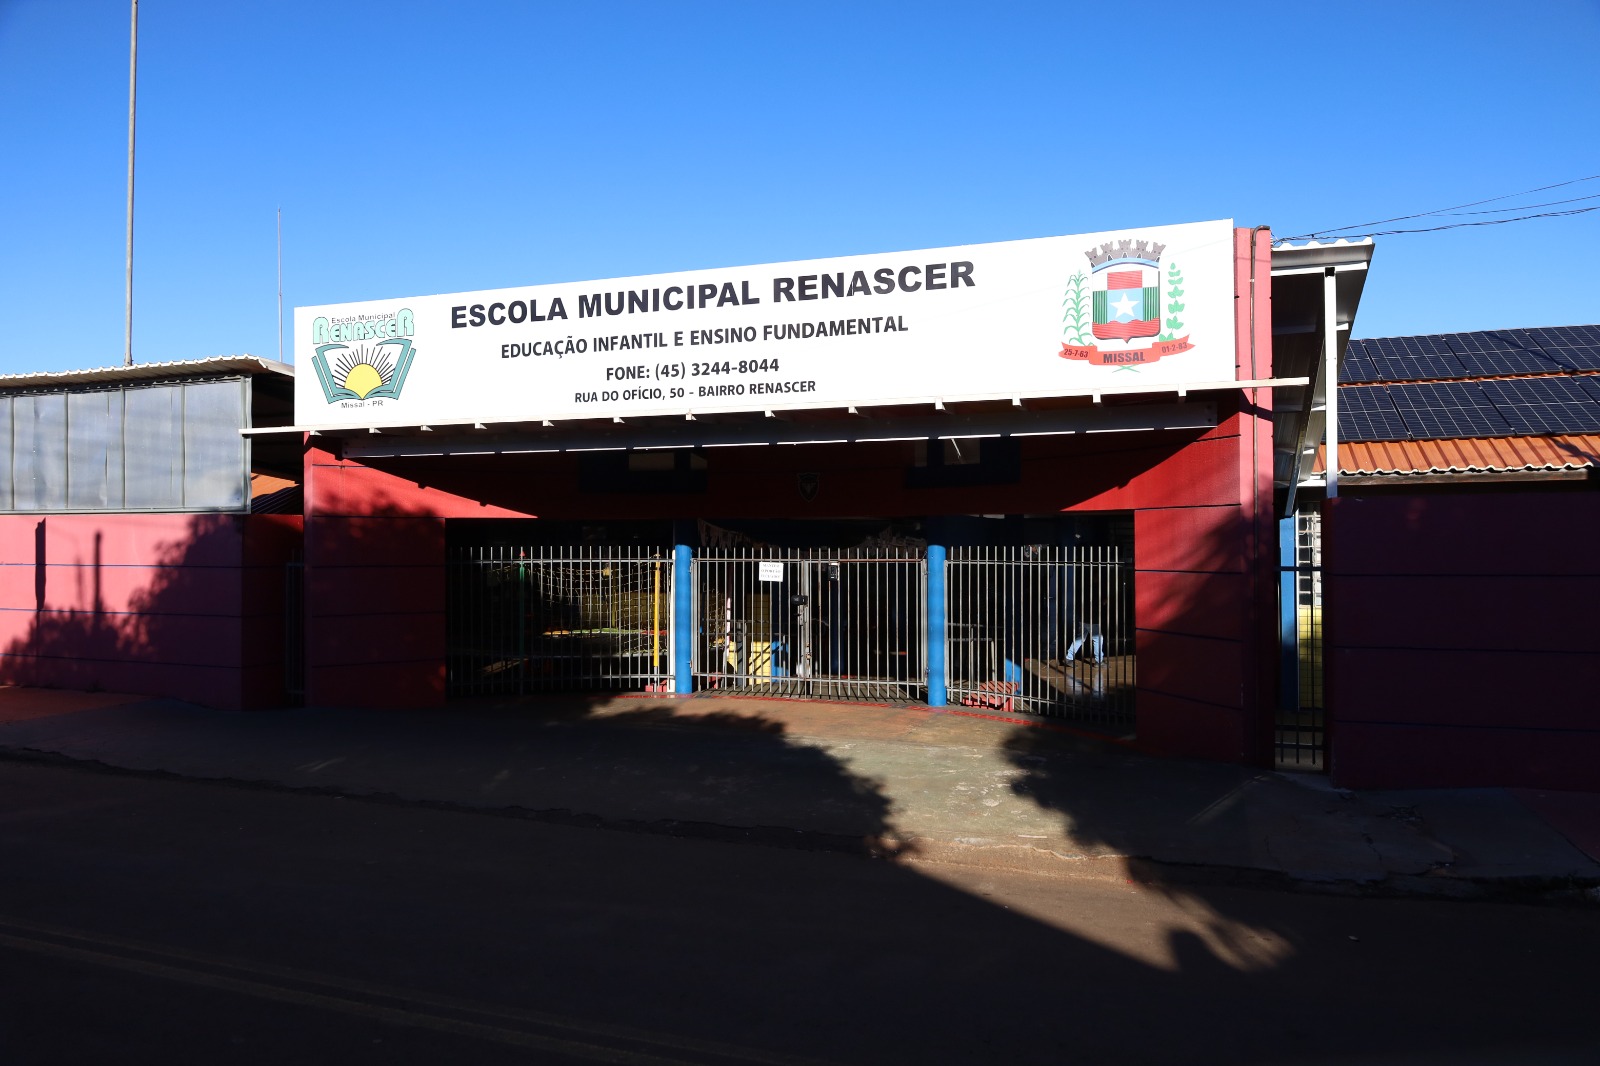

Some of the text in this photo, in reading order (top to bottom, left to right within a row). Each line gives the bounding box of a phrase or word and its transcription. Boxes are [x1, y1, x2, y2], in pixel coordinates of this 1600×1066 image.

[451, 260, 976, 329] ESCOLA MUNICIPAL RENASCER
[313, 308, 414, 344] RENASCER
[331, 312, 396, 324] Escola Municipal
[501, 315, 909, 359] EDUCAÇÃO INFANTIL E ENSINO FUNDAMENTAL
[1063, 348, 1089, 359] 25-7-63
[1161, 342, 1188, 354] 01-2-83
[1103, 351, 1145, 364] MISSAL
[606, 358, 780, 381] FONE: (45) 3244-8044
[574, 391, 598, 403] RUA
[601, 390, 619, 402] DO
[622, 385, 666, 401] OFÍCIO,
[669, 387, 685, 398] 50
[698, 384, 745, 397] BAIRRO
[749, 380, 816, 395] RENASCER
[341, 401, 365, 409] Missal
